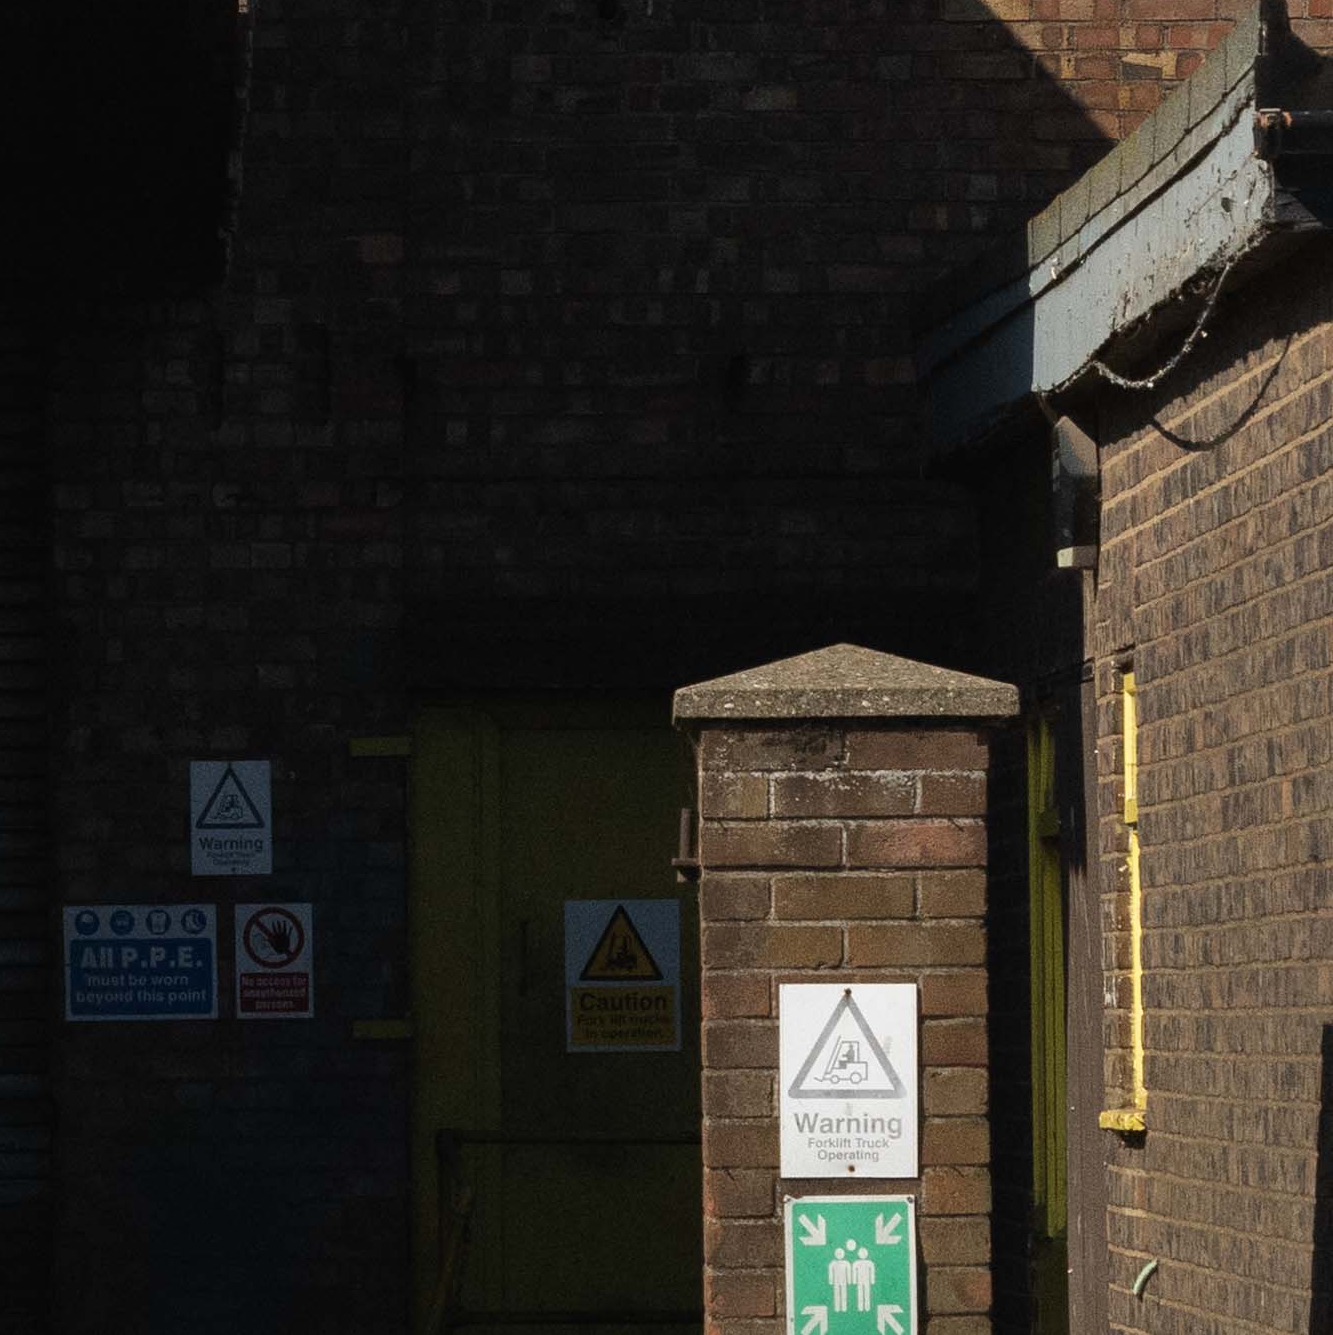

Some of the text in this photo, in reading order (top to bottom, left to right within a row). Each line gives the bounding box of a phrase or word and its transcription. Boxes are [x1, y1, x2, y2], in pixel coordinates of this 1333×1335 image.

[199, 835, 264, 853] Warning
[80, 946, 203, 969] All P.P.E.
[87, 974, 189, 987] must be worn
[76, 989, 206, 1006] beyond this point
[580, 992, 666, 1011] Caution
[794, 1112, 902, 1139] Warning
[808, 1137, 890, 1148] Forklift Truck
[817, 1149, 879, 1163] Operating
